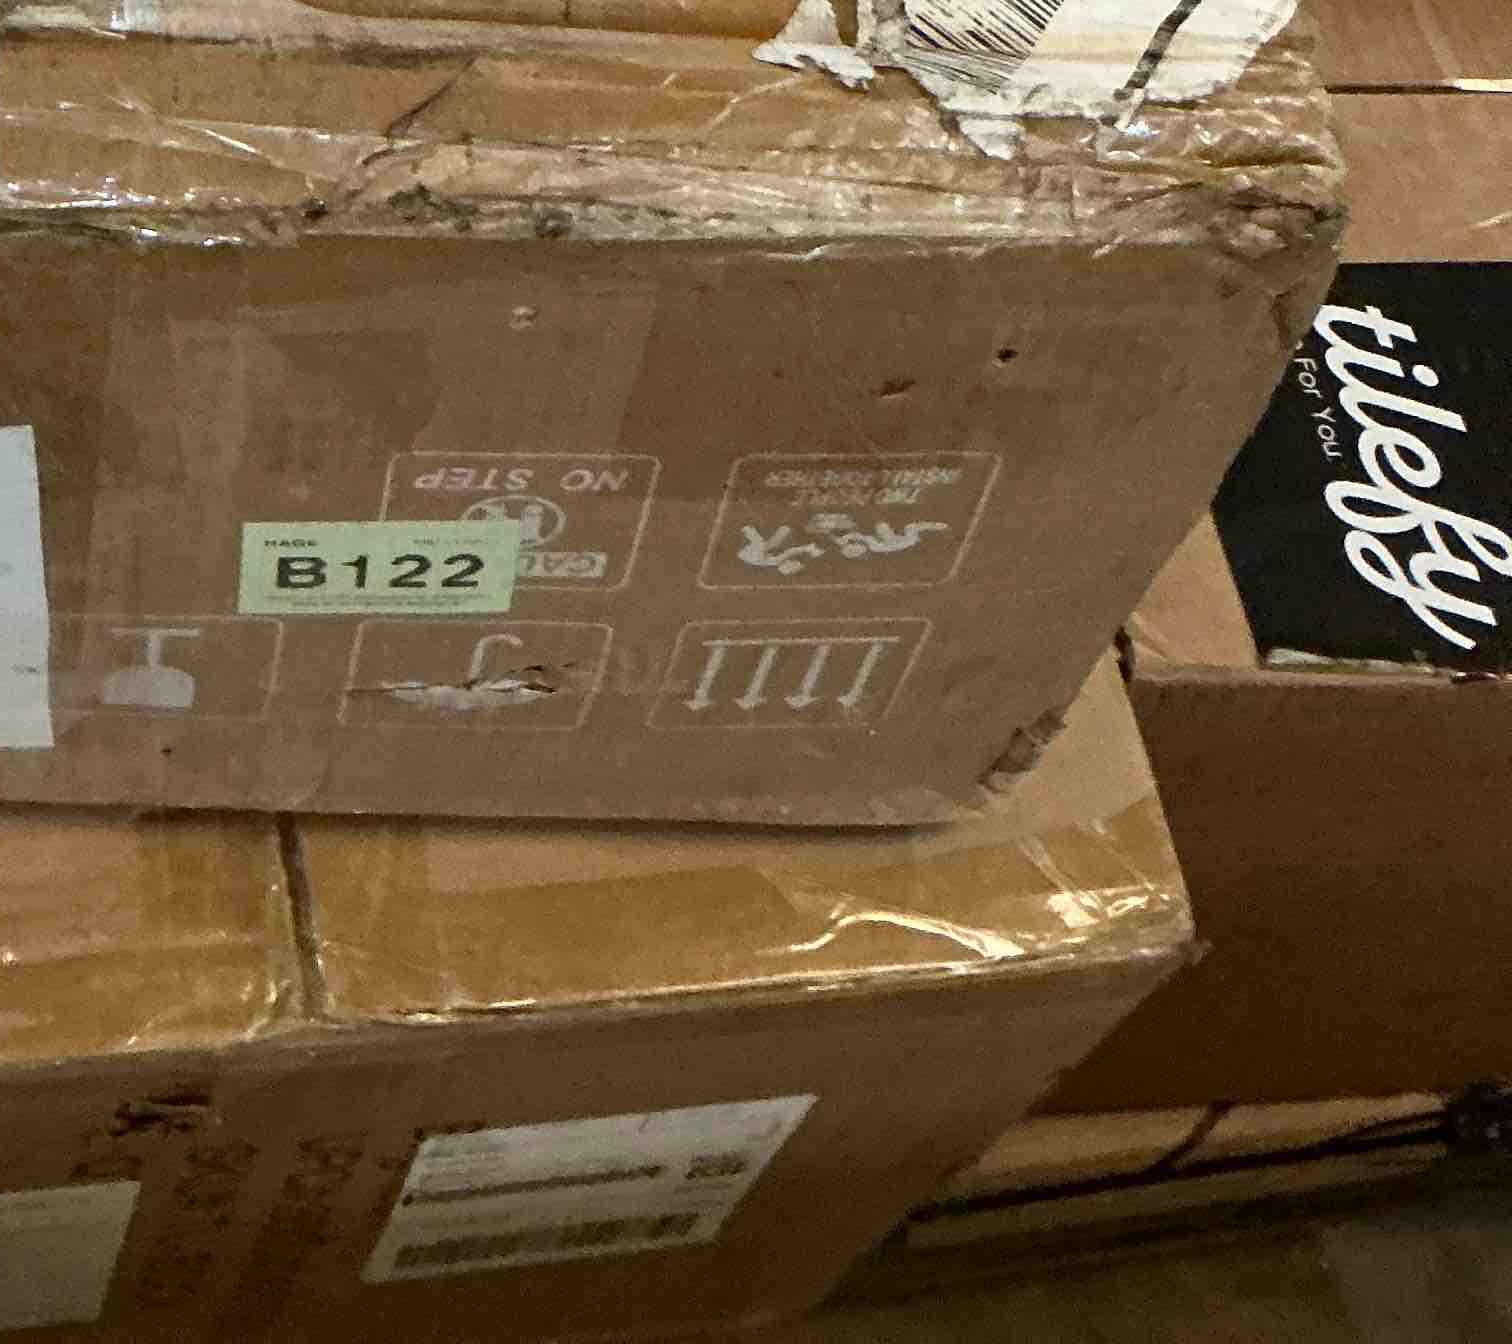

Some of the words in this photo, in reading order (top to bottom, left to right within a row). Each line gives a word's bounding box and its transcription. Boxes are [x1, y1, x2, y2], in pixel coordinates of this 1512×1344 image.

[1294, 357, 1321, 399] For
[1312, 408, 1342, 462] You
[413, 467, 535, 491] STEP
[559, 469, 629, 492] NO
[276, 552, 486, 589] B122
